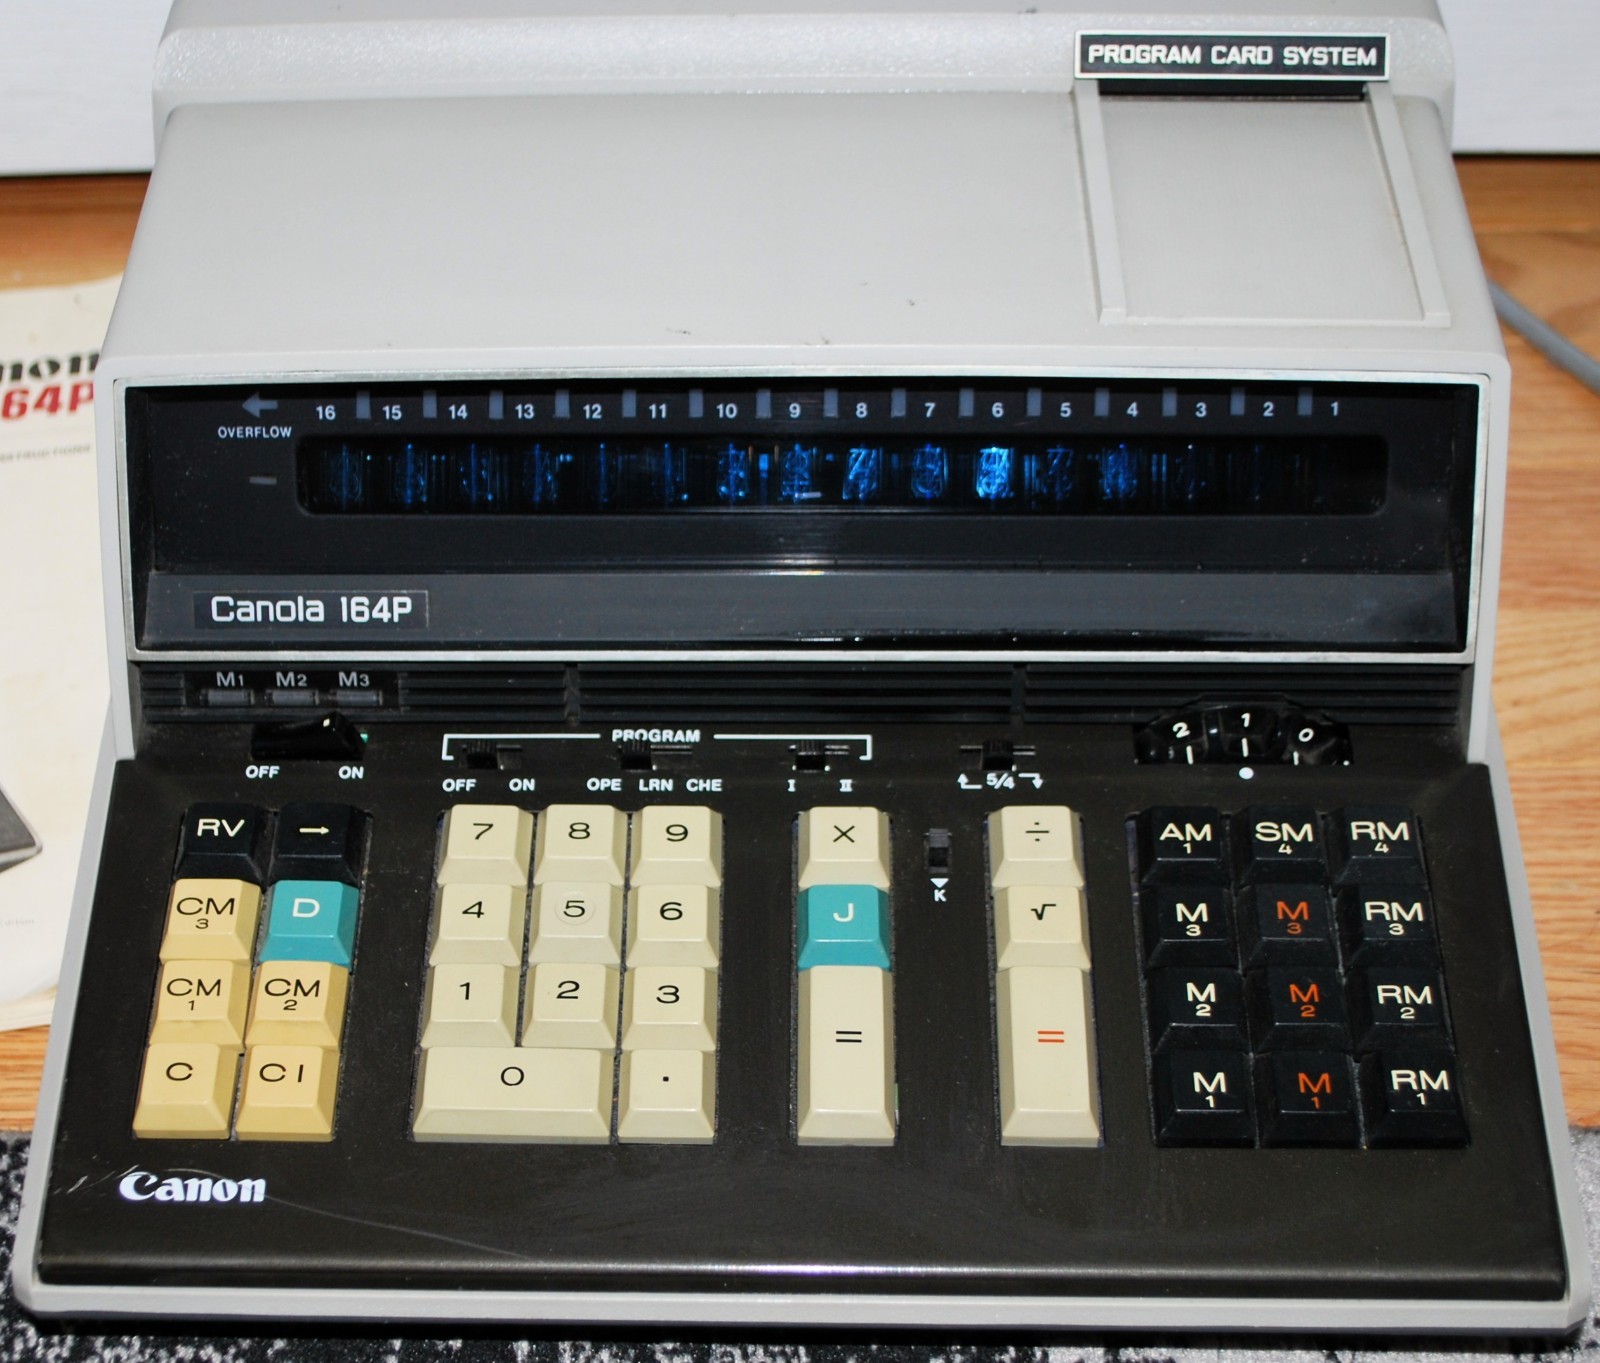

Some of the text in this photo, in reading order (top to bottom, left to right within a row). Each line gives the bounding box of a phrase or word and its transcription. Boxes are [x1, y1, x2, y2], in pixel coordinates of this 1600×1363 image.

[1089, 45, 1376, 65] PROGRAM CARD SYSTEM
[317, 405, 335, 420] 16
[383, 405, 402, 420] 15
[449, 404, 467, 419] 14
[515, 404, 534, 419] 13
[584, 404, 601, 419] 12
[649, 404, 666, 418] 11
[717, 403, 737, 418] 10
[789, 403, 800, 418] 9
[856, 402, 867, 418] 8
[925, 403, 935, 417] 7
[992, 402, 1004, 417] 6
[1061, 402, 1071, 417] 5
[1127, 402, 1138, 417] 4
[1196, 402, 1206, 417] 3
[1264, 402, 1273, 416] 2
[1331, 402, 1338, 416] 1
[218, 426, 291, 438] OVERFLOW
[211, 595, 411, 622] Canola 164P
[1242, 713, 1250, 727] 1
[612, 729, 700, 742] PROGRAM
[1173, 722, 1190, 738] 2
[246, 765, 279, 778] OFF
[339, 766, 364, 779] ON
[442, 779, 476, 792] OFF
[509, 778, 535, 791] ON
[587, 778, 621, 791] OPE
[639, 779, 673, 791] LRN
[686, 779, 722, 791] CHE
[987, 773, 1015, 789] 5/4
[197, 819, 244, 837] RV
[473, 823, 493, 840] 7
[569, 823, 590, 839] 8
[666, 825, 688, 842] 9
[1160, 823, 1211, 841] AM
[1255, 822, 1313, 842] SM
[1351, 821, 1409, 840] RM
[1183, 843, 1191, 854] 1
[1279, 844, 1292, 854] 4
[1375, 842, 1389, 853] 4
[934, 889, 946, 901] K
[177, 898, 235, 915] CM
[293, 898, 320, 917] D
[462, 901, 484, 918] 4
[564, 901, 585, 917] 5
[660, 902, 682, 920] 6
[833, 903, 853, 922] J
[1176, 903, 1208, 922] M
[1277, 901, 1308, 920] M
[1365, 902, 1423, 921] RM
[196, 919, 208, 929] 3
[1186, 924, 1201, 936] 3
[1287, 922, 1301, 934] 3
[1389, 923, 1404, 935] 3
[167, 978, 221, 996] CM
[265, 979, 320, 997] CM
[460, 982, 470, 1000] 1
[557, 981, 579, 999] 2
[657, 985, 679, 1003] 3
[1187, 983, 1215, 1002] M
[1290, 984, 1319, 1002] M
[1377, 985, 1432, 1004] RM
[189, 1000, 194, 1010] 1
[284, 1000, 297, 1010] 2
[1196, 1004, 1211, 1016] 2
[1301, 1005, 1315, 1017] 2
[1400, 1007, 1415, 1019] 2
[166, 1063, 193, 1081] C
[1193, 1072, 1226, 1092] M
[1298, 1073, 1331, 1093] M
[1391, 1070, 1449, 1090] RM
[1206, 1095, 1214, 1107] 1
[1312, 1097, 1319, 1108] 1
[1417, 1093, 1425, 1105] 1
[119, 1171, 266, 1202] Canon
